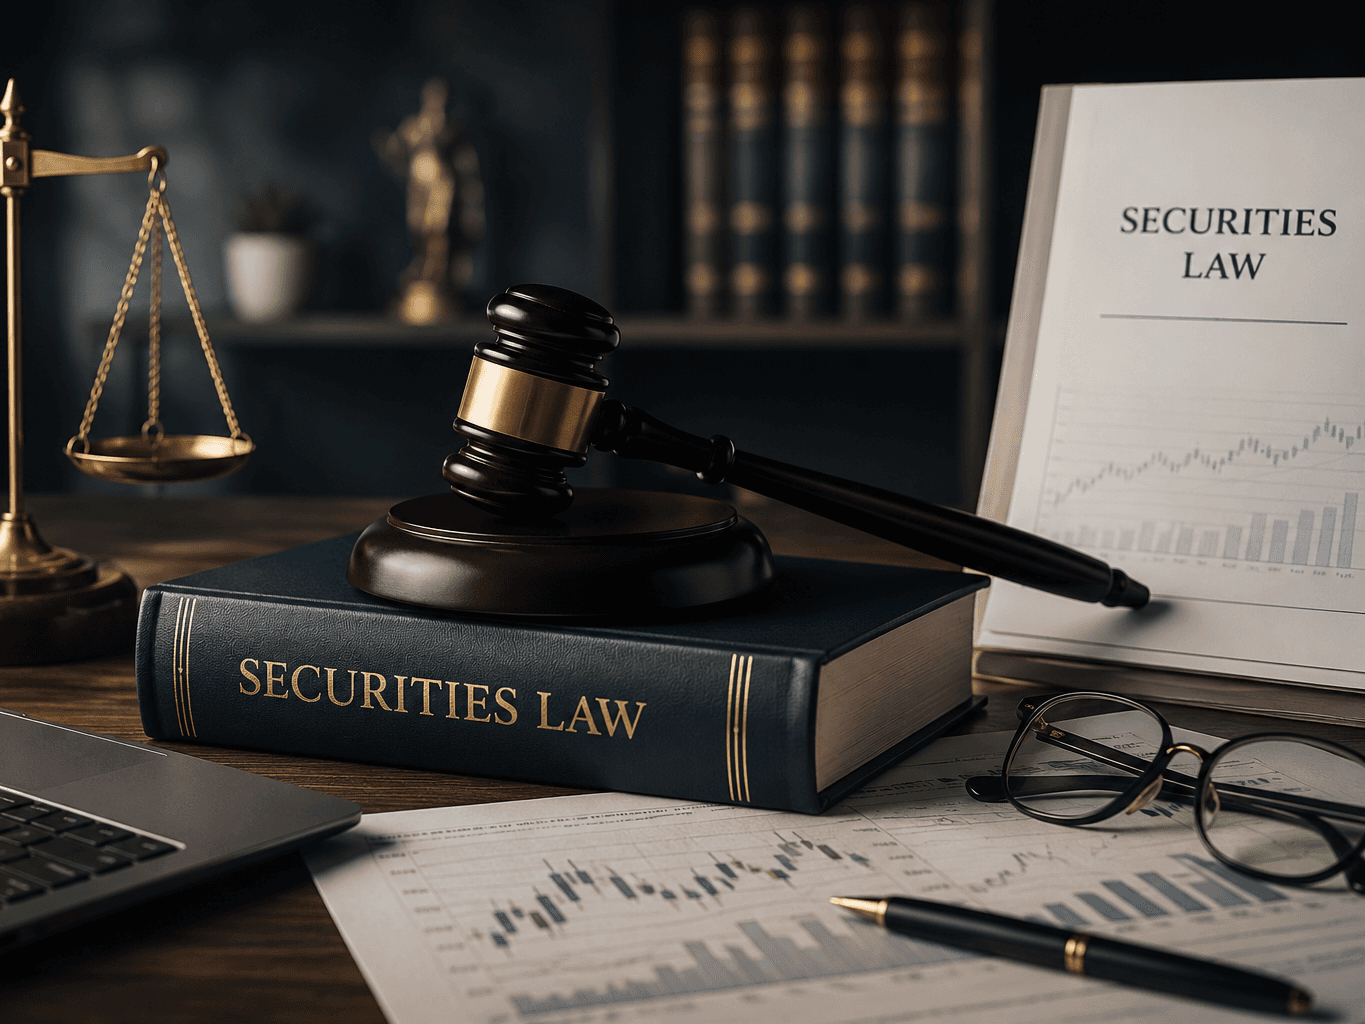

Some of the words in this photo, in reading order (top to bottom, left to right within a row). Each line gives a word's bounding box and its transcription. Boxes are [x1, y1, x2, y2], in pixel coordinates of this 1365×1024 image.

[1120, 206, 1337, 237] SECURITIES
[1182, 251, 1266, 280] LAW
[238, 657, 519, 726] SECURITIES
[536, 691, 647, 740] LAW
